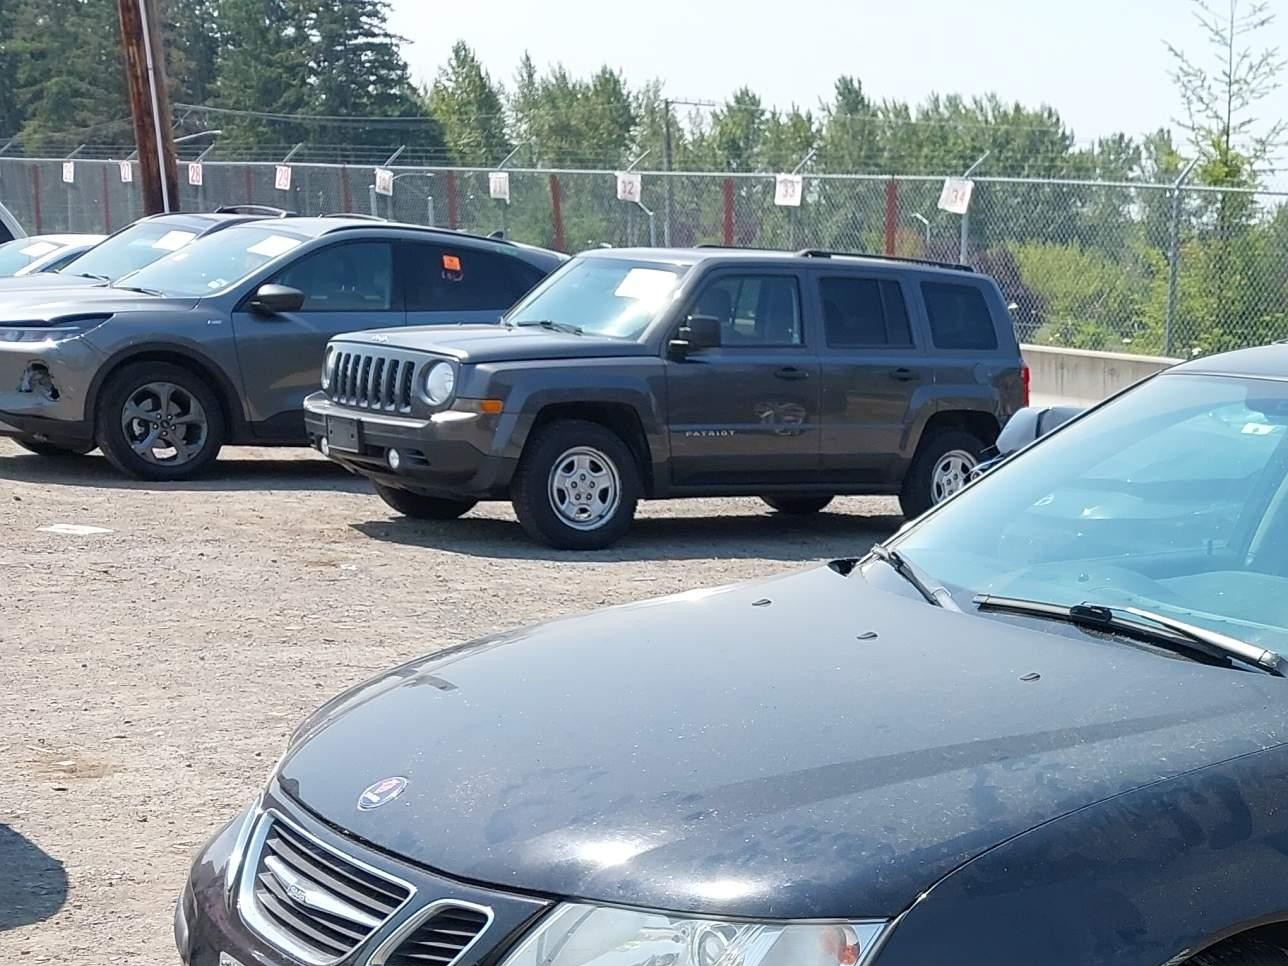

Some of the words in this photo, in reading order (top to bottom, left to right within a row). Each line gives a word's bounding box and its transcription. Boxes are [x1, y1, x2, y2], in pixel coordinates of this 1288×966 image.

[190, 165, 200, 183] 28
[279, 167, 290, 187] 29
[622, 180, 634, 195] 32
[685, 429, 736, 438] PATRIOT
